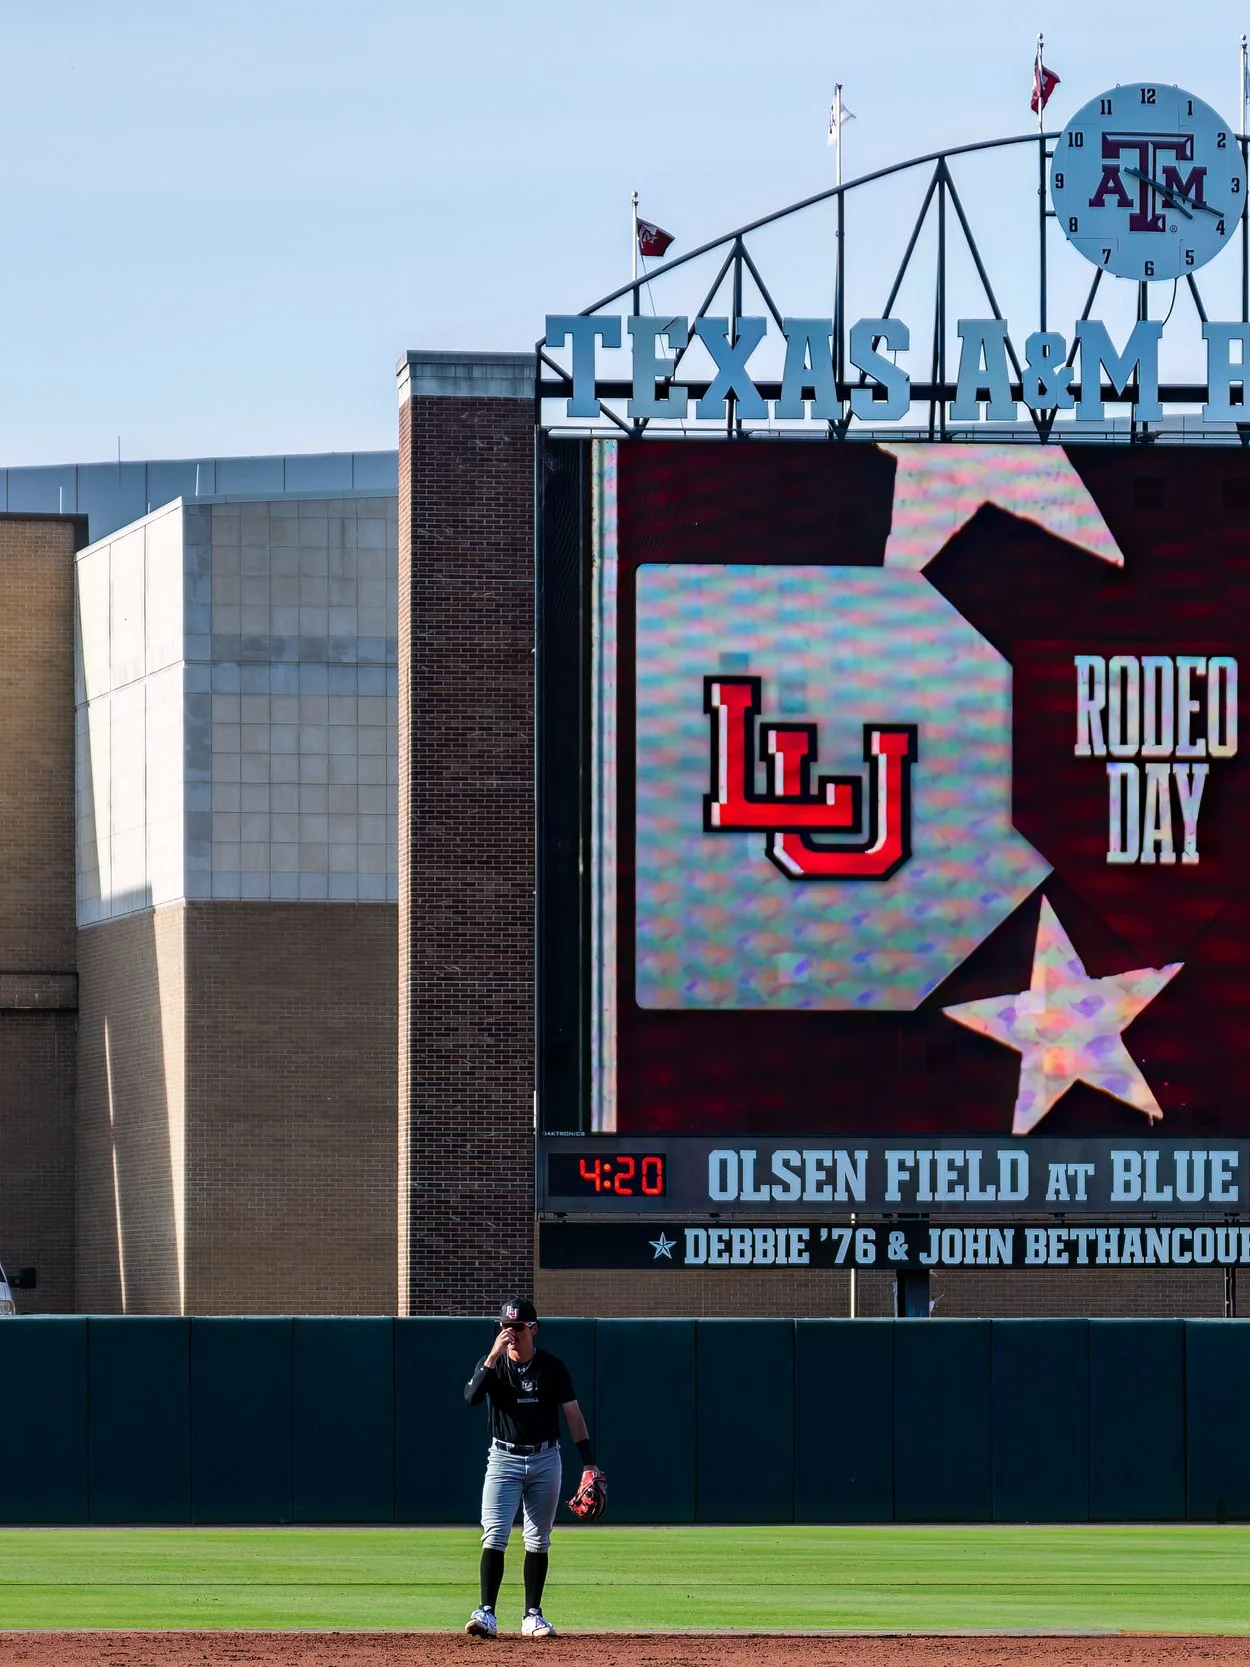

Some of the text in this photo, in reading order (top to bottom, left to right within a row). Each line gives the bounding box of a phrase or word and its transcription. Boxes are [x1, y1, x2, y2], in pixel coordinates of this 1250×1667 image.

[1140, 88, 1156, 104] 12
[1100, 99, 1113, 115] 11
[1187, 100, 1193, 116] 1
[1068, 132, 1084, 148] 10
[1217, 132, 1226, 148] 2
[1055, 173, 1064, 189] 9
[1231, 177, 1240, 193] 3
[1069, 217, 1078, 233] 8
[1216, 219, 1226, 235] 4
[1102, 249, 1111, 264] 7
[1185, 250, 1195, 266] 5
[1144, 261, 1154, 277] 6
[545, 314, 910, 421] TEXAS
[949, 319, 1164, 422] A&M
[1074, 655, 1239, 758] RODEO
[1106, 762, 1210, 865] DAY
[580, 1156, 663, 1195] 4:20
[707, 1149, 869, 1201] OLSEN
[884, 1149, 1029, 1201] FIELD
[1046, 1163, 1095, 1202] AT
[1110, 1150, 1239, 1202] BLUE
[684, 1228, 811, 1264] DEBBIE
[820, 1228, 876, 1264] '76
[888, 1230, 909, 1261] &
[919, 1228, 1015, 1264] JOHN
